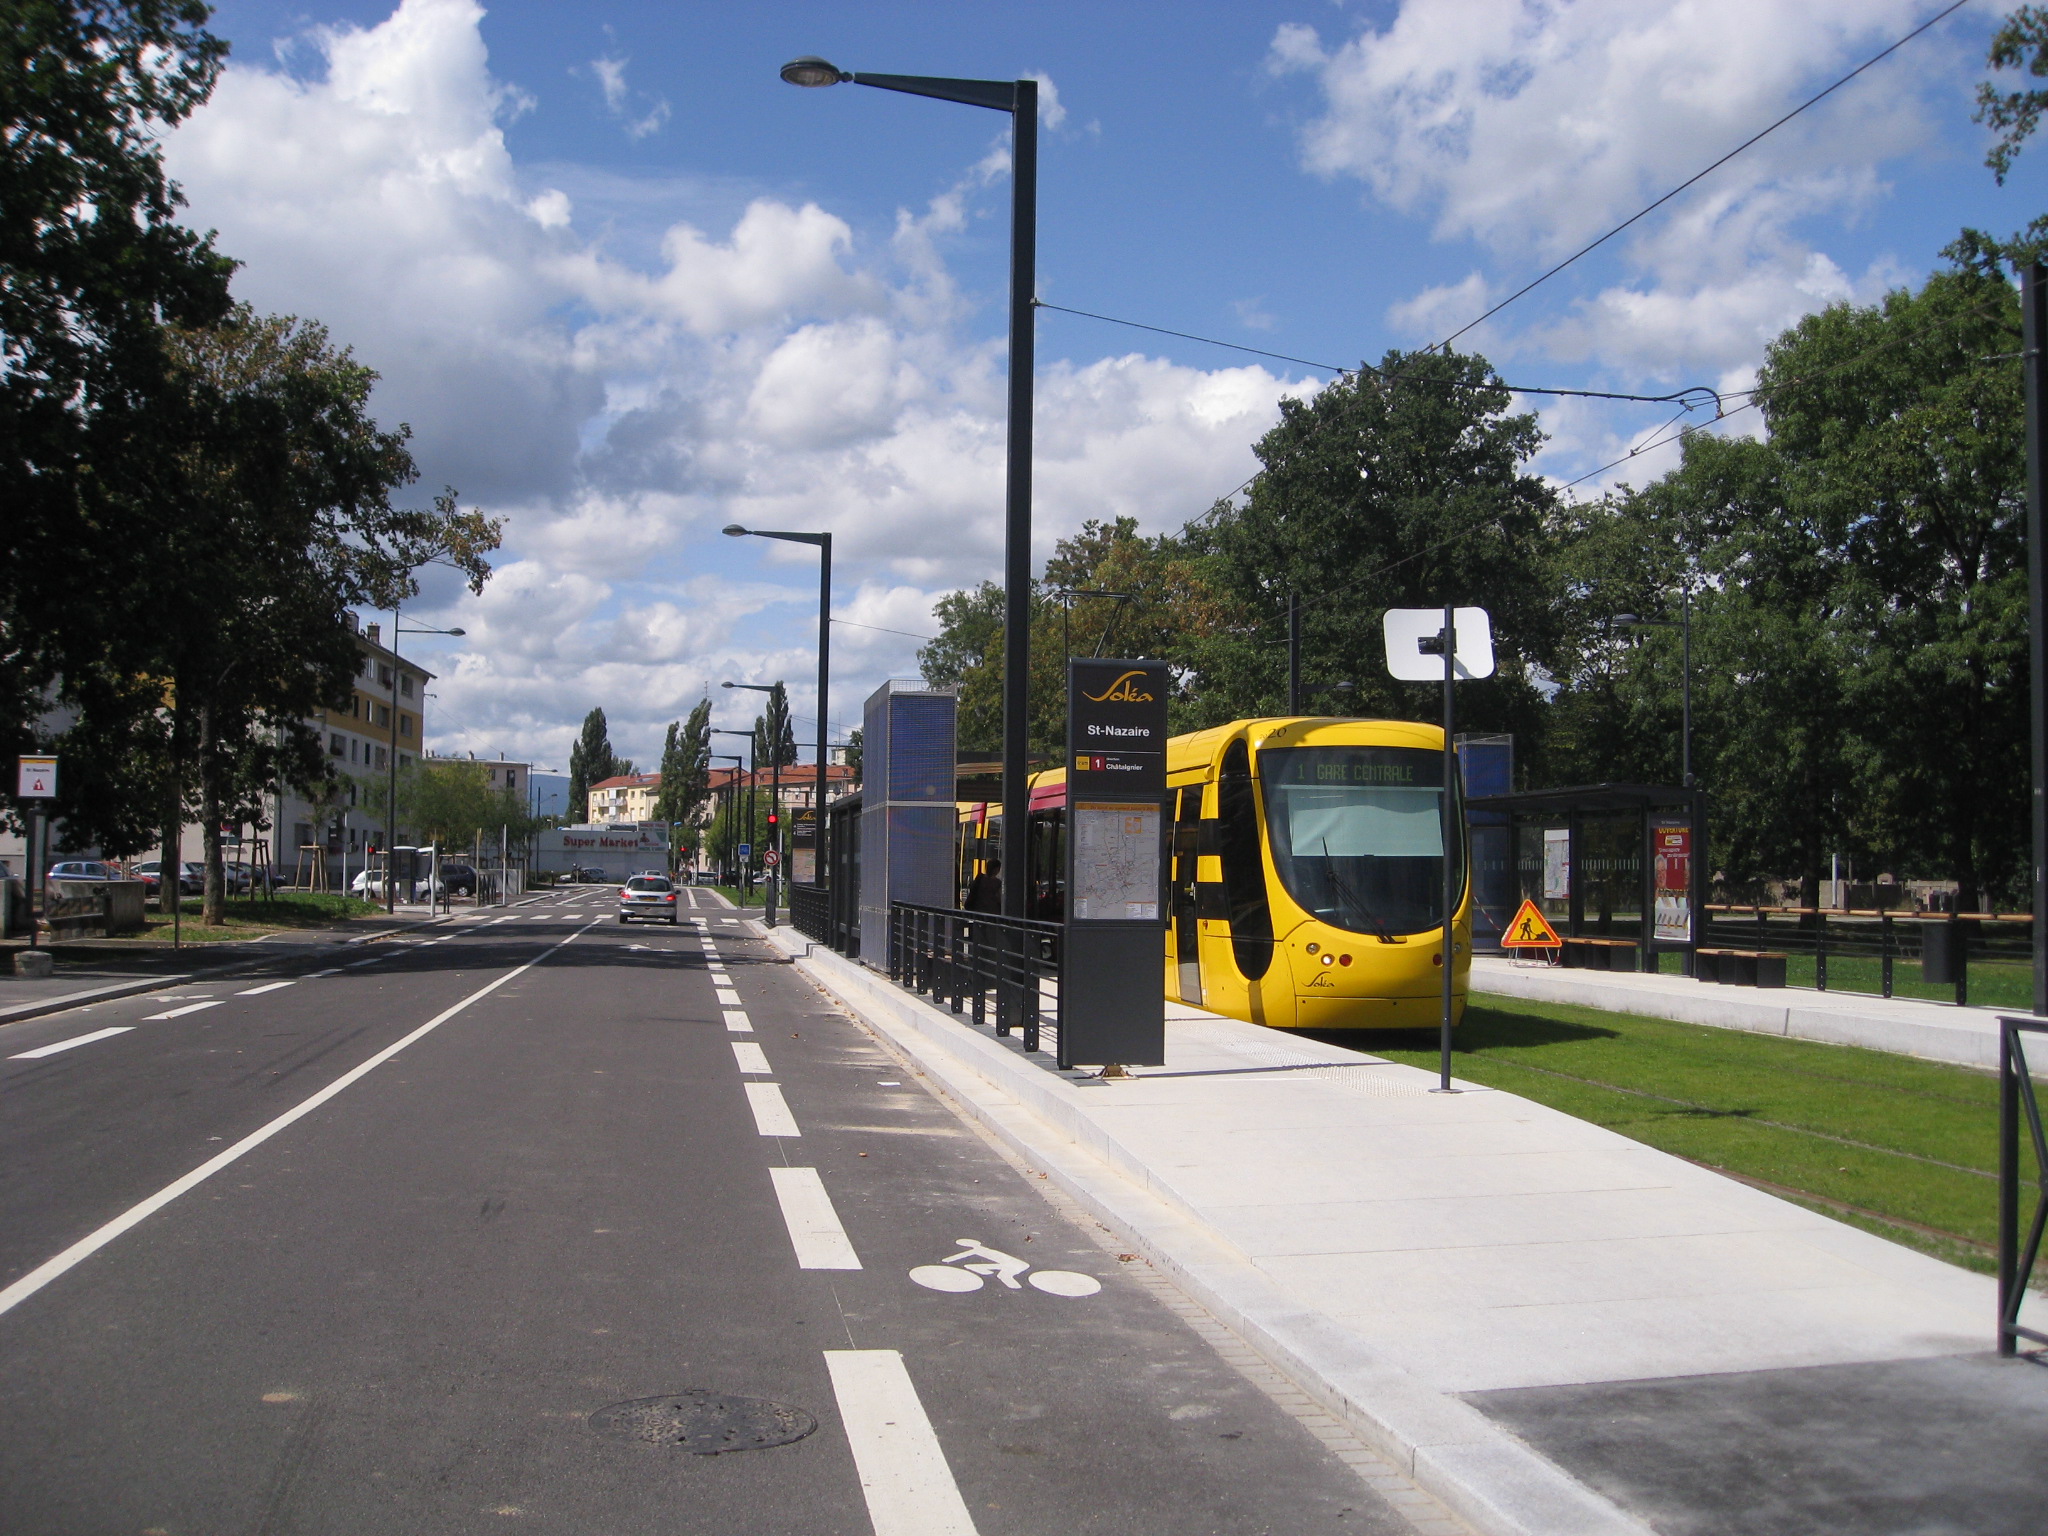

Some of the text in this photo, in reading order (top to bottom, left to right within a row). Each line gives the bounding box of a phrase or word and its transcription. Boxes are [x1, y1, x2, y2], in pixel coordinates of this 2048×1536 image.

[1082, 670, 1154, 702] Soléa
[1087, 724, 1150, 737] St-Nazaire
[1095, 759, 1101, 768] 1
[1105, 763, 1144, 771] Châtaignier
[1298, 764, 1413, 782] 1 GARE CENTRALE
[563, 835, 638, 848] Super Market
[1301, 971, 1335, 988] Soléa
